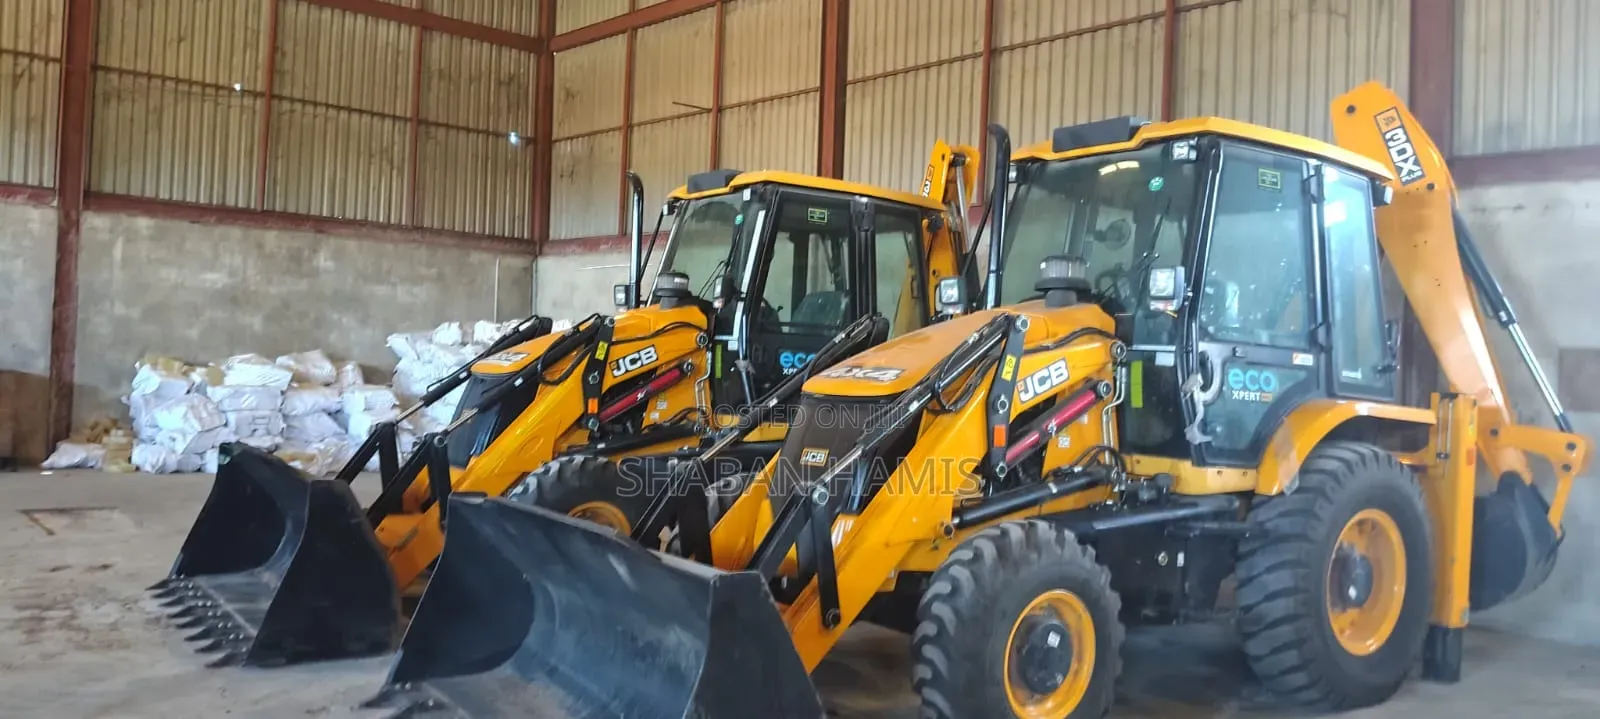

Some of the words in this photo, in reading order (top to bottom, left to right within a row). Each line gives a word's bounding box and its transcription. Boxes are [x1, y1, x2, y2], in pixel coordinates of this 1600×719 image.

[612, 346, 658, 377] JCB
[1019, 358, 1069, 402] JCB
[1228, 367, 1276, 391] eco
[1231, 390, 1261, 401] XPERT
